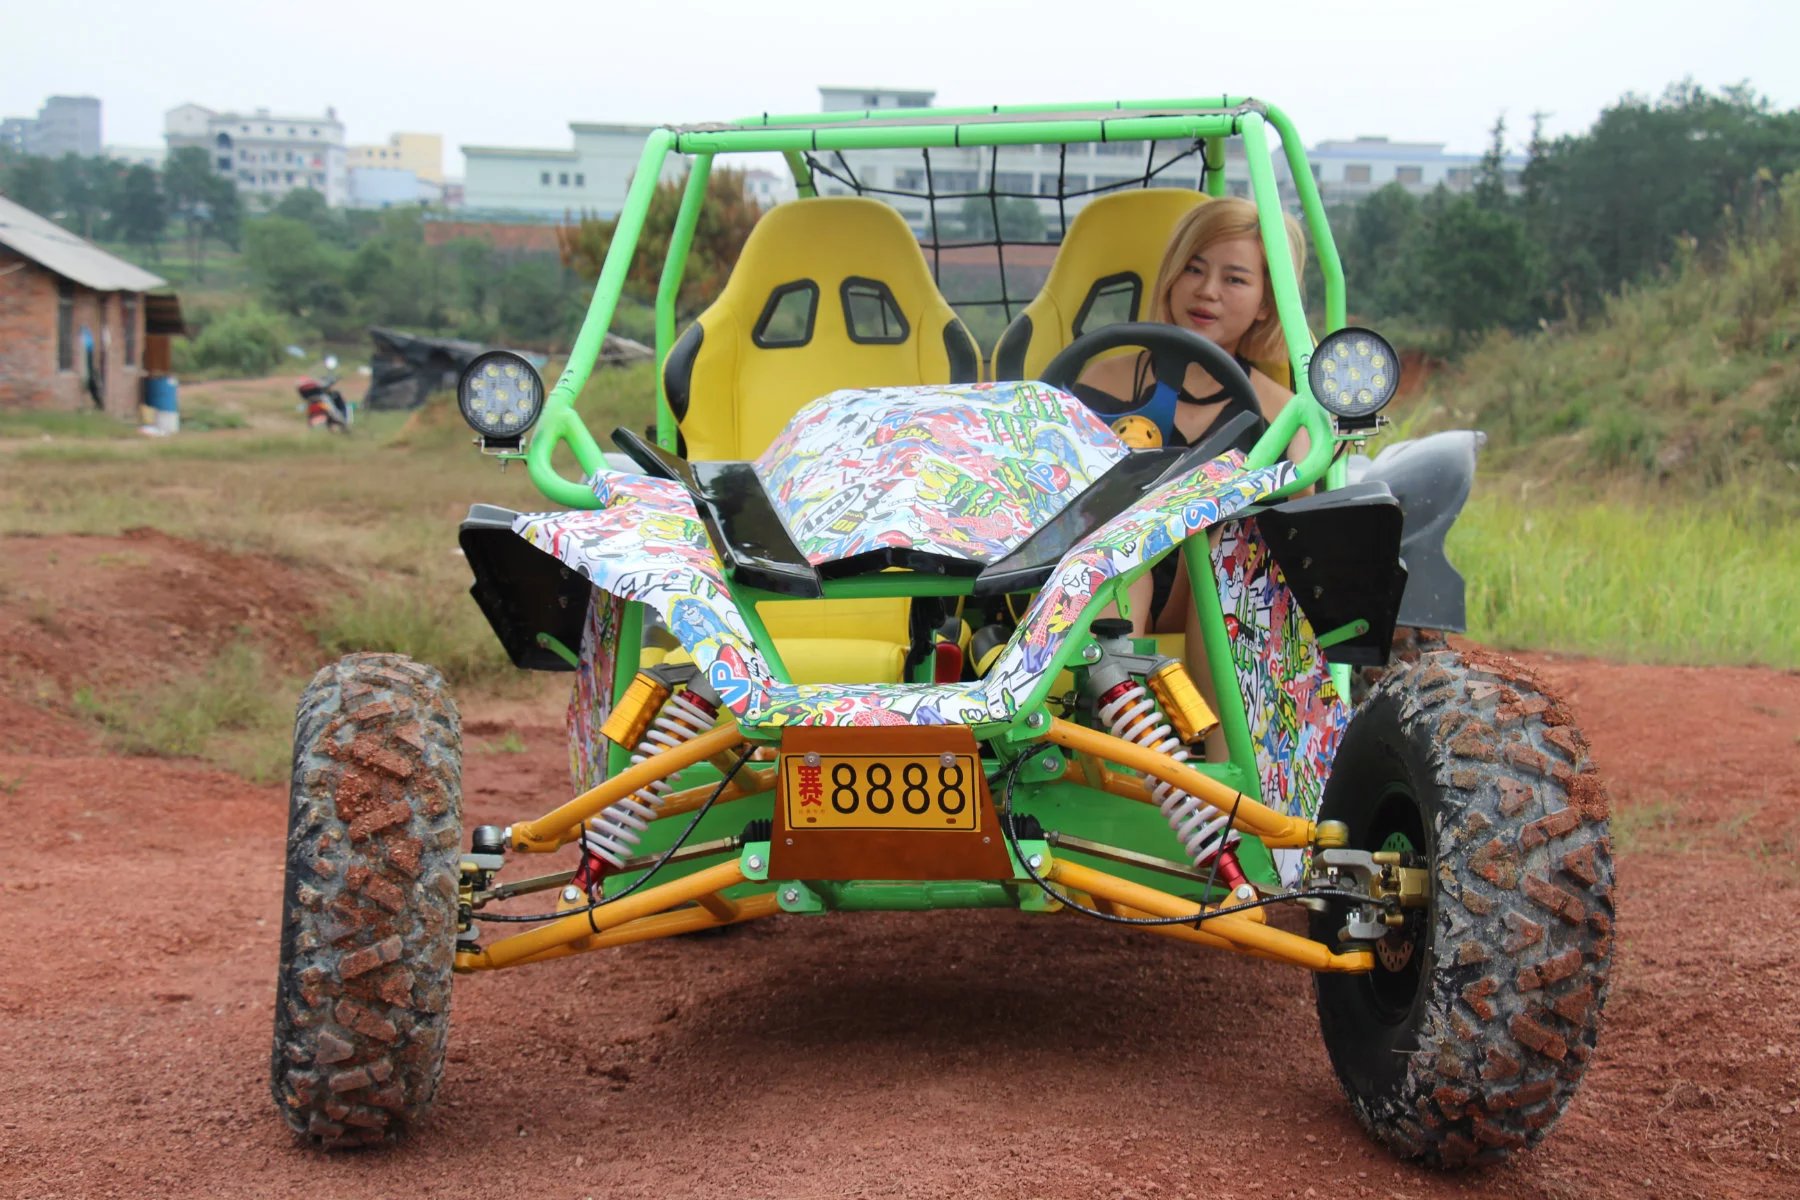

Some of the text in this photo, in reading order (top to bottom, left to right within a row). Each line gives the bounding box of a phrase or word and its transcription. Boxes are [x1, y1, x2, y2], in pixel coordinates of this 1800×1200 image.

[1025, 462, 1060, 494] VP
[801, 490, 854, 539] Arai
[709, 660, 751, 707] VP
[831, 762, 966, 815] 8888
